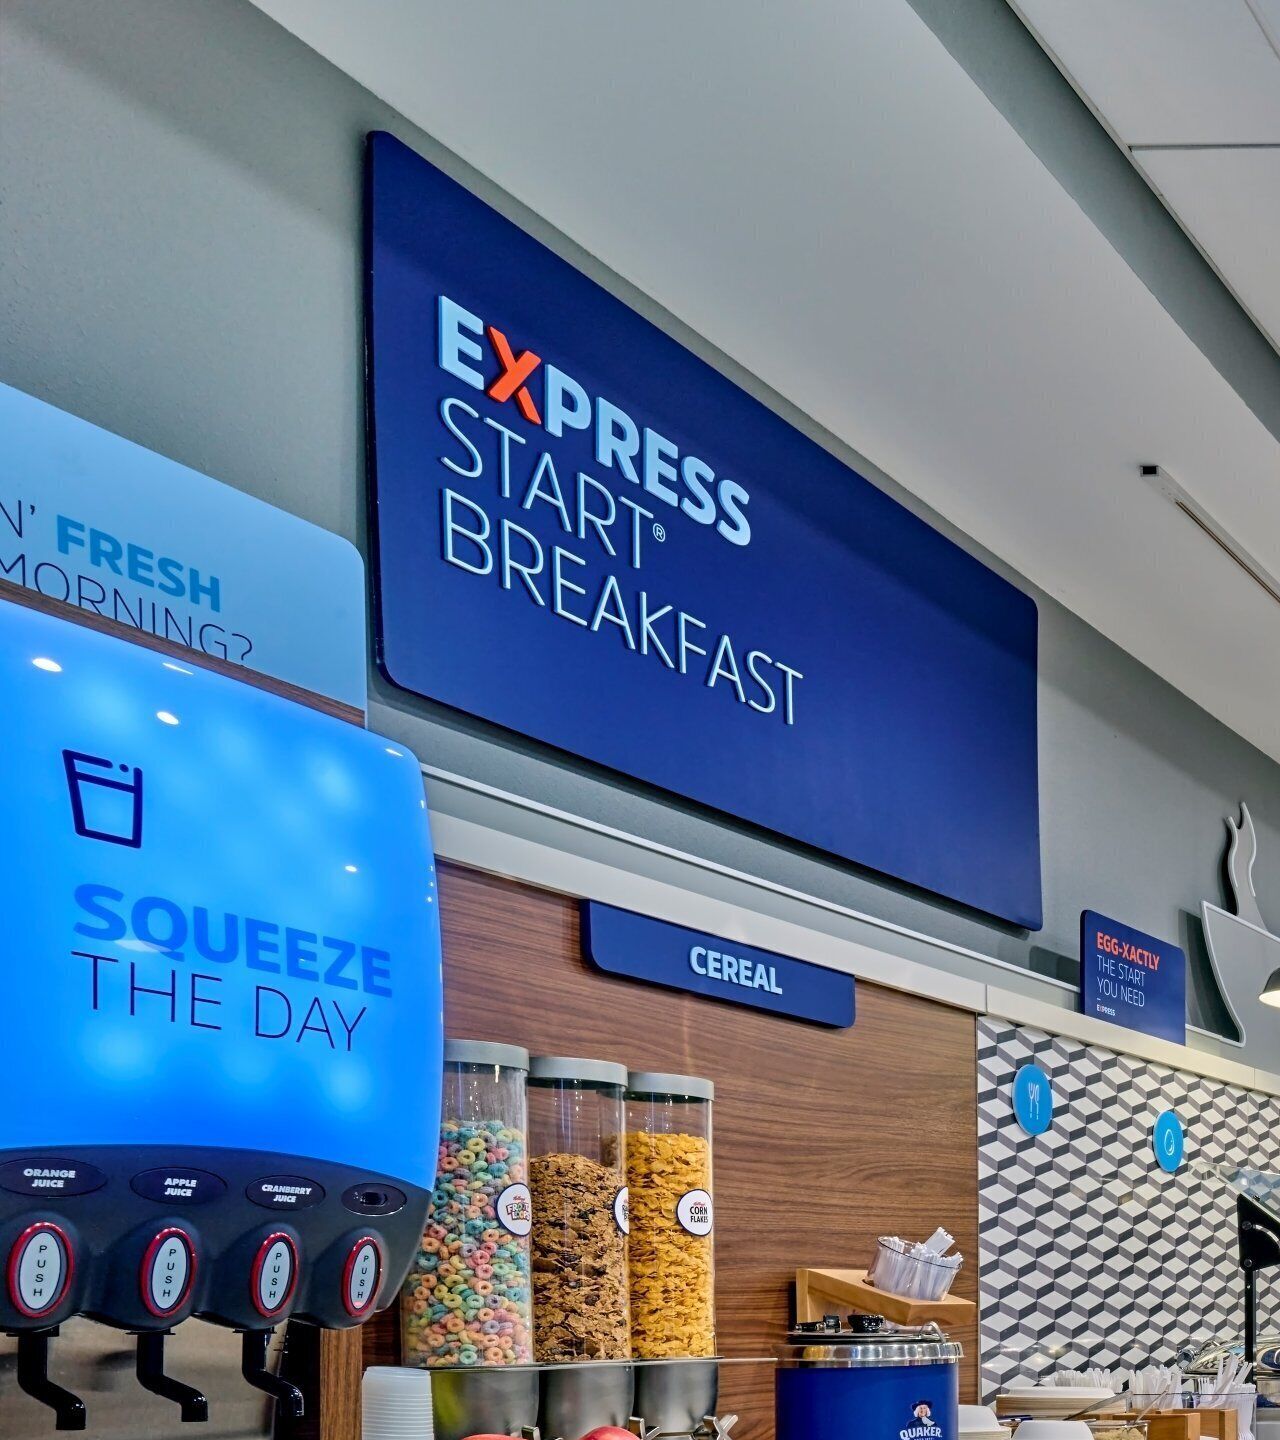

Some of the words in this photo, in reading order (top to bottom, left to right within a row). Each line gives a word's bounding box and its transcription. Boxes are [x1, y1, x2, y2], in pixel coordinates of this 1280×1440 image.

[439, 295, 751, 547] EXPRESS
[56, 514, 221, 613] FRESH
[0, 553, 253, 666] MORNING?
[442, 488, 804, 725] BREAKFAST
[73, 883, 393, 998] SQUEEZE
[1097, 931, 1160, 971] EGG-XACTLY
[689, 946, 783, 995] CEREAL
[1097, 954, 1116, 977] THE
[1118, 963, 1146, 987] START
[71, 950, 222, 1031] THE
[254, 985, 367, 1052] DAY
[1097, 976, 1118, 998] YOU
[1120, 985, 1145, 1007] NEED
[23, 1167, 76, 1179] ORANGE
[32, 1178, 65, 1188] JUICE
[164, 1177, 197, 1188] APPLE
[164, 1187, 192, 1197] JUICE
[261, 1184, 312, 1195] CRANBERRY
[273, 1194, 297, 1203] JUICE
[689, 1206, 708, 1215] CORN
[690, 1215, 709, 1223] FLAKES
[33, 1244, 47, 1297] PUSH
[163, 1248, 177, 1297] PUSH
[269, 1252, 282, 1298] PUSH
[357, 1255, 370, 1299] PUSH
[899, 1426, 943, 1440] QUAKER
